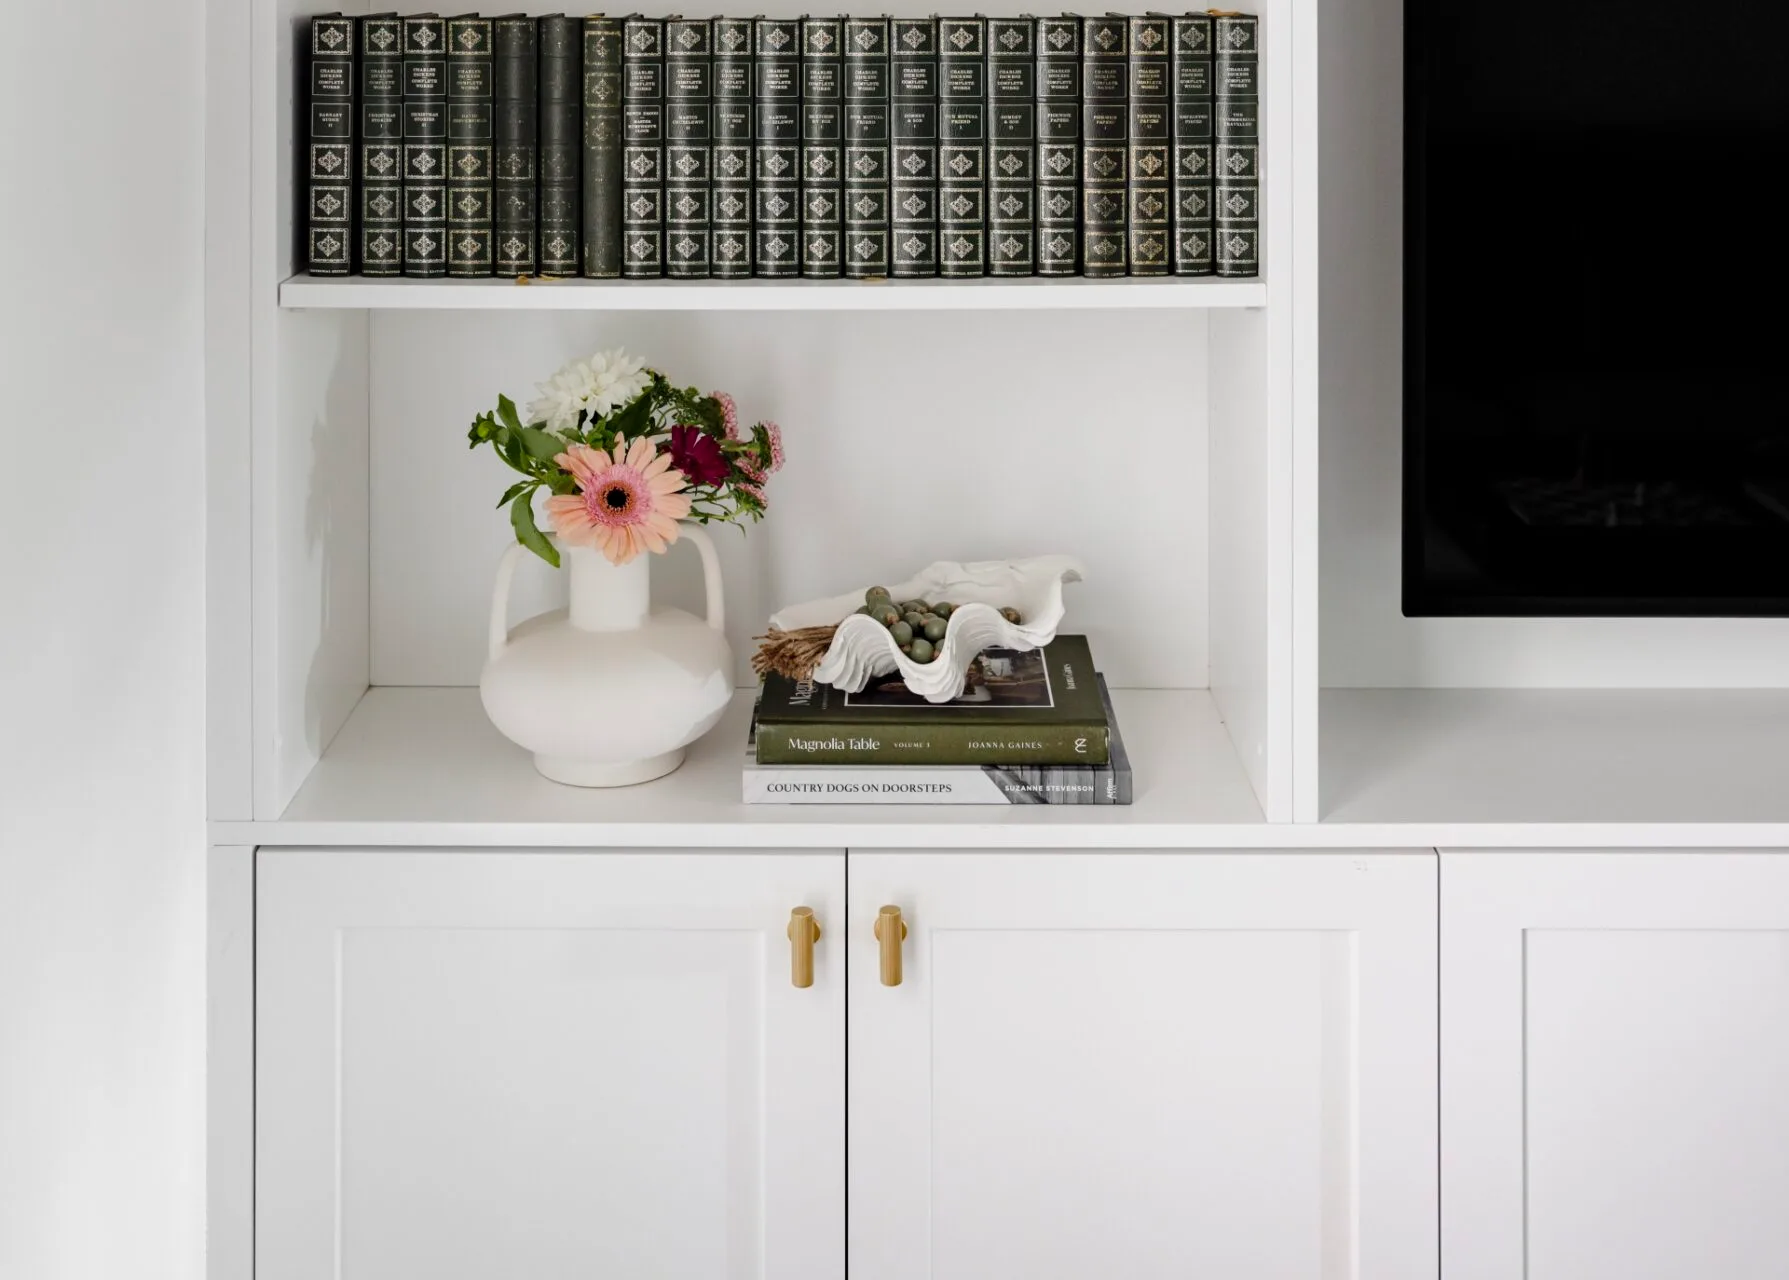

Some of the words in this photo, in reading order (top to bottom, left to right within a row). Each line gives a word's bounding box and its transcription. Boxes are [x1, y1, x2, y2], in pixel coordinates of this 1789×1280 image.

[788, 737, 846, 752] Magnolia
[847, 737, 880, 751] Table
[893, 741, 924, 749] VOLUME
[968, 740, 1005, 749] JOANNA
[1007, 740, 1043, 749] GAINES
[766, 783, 824, 793] COUNTRY
[826, 783, 859, 793] DOGS
[861, 783, 880, 793] ON
[882, 783, 953, 793] DOORSTEPS
